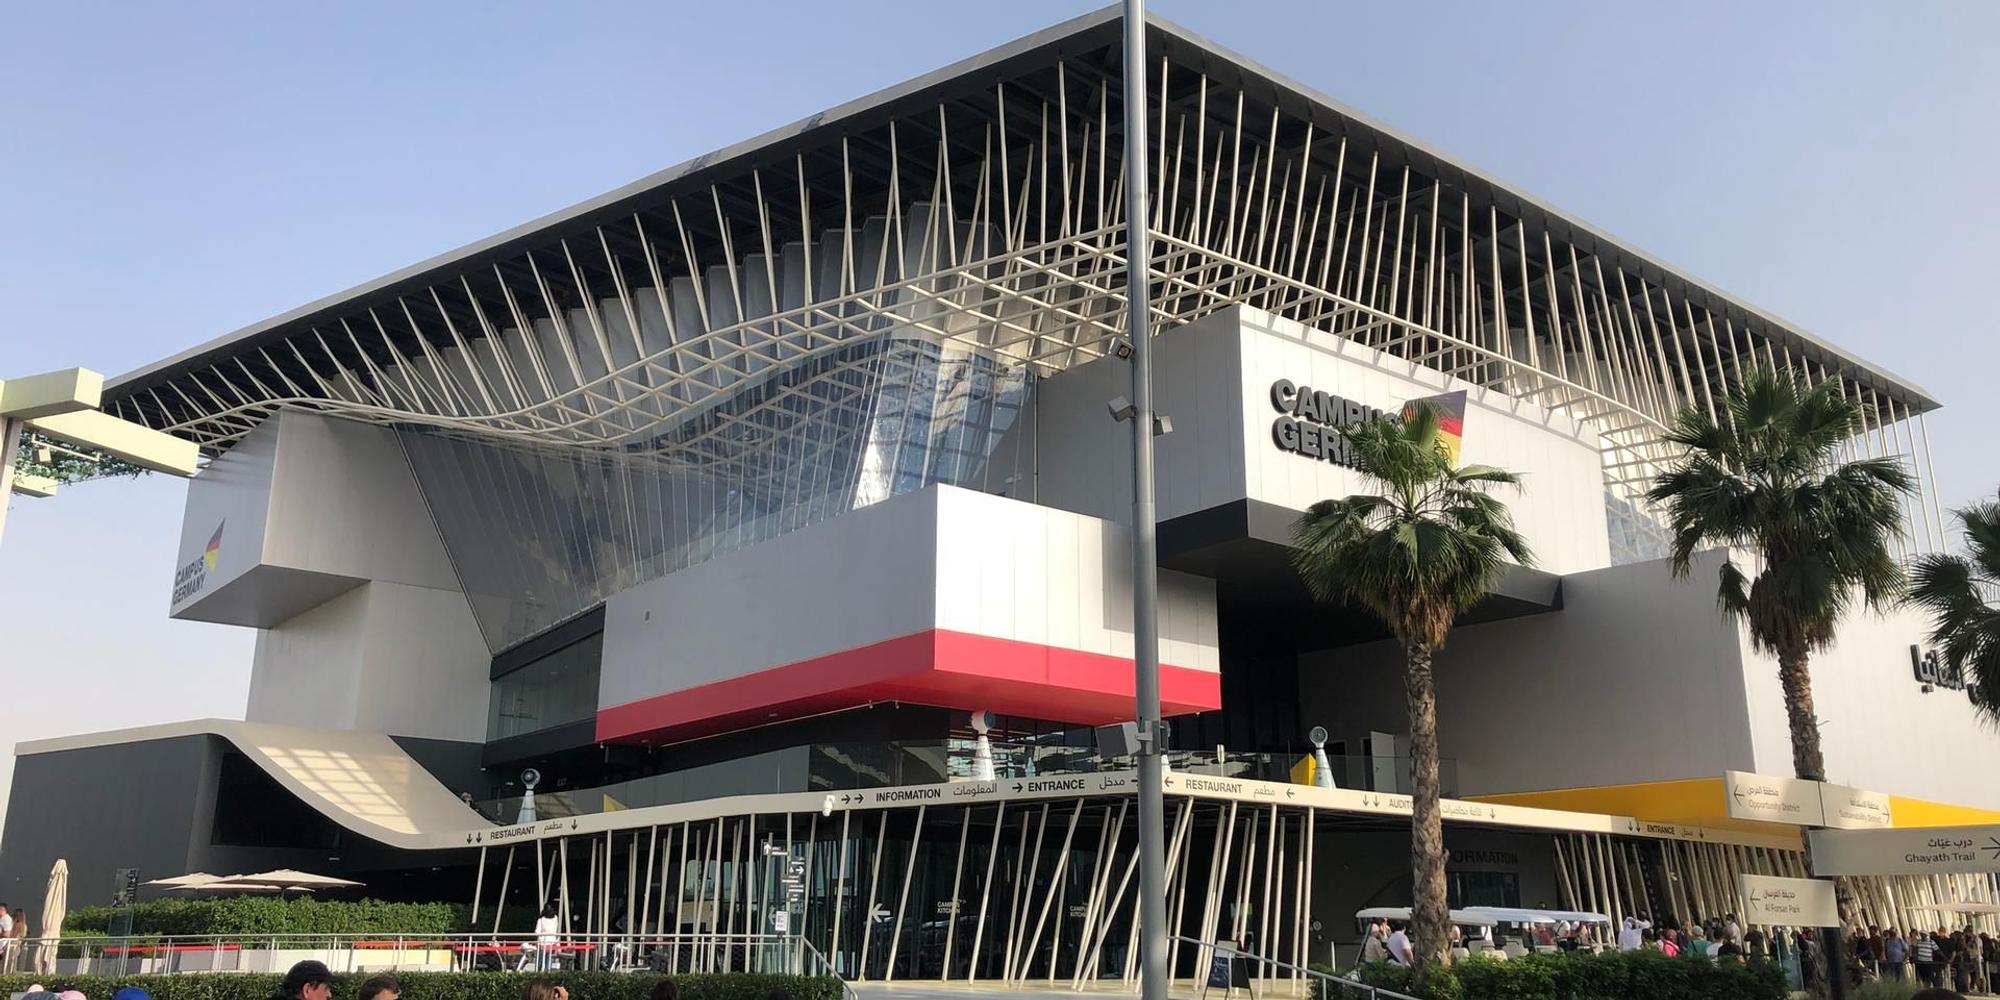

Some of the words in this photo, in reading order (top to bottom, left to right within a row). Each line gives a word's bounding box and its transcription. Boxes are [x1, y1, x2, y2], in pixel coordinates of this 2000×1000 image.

[175, 555, 205, 587] CAMPUS
[172, 571, 207, 606] GERMANY
[1028, 779, 1085, 792] ENTRANCE
[1099, 776, 1126, 790] مدخل
[1185, 779, 1243, 794] RESTAURANT
[876, 788, 941, 802] INFORMATION
[953, 783, 998, 798] المعلومات
[1253, 784, 1276, 798] مطعم
[1389, 799, 1414, 809] AUDIT
[490, 826, 536, 840] RESTAURANT
[544, 821, 563, 834] مطعم
[1646, 824, 1675, 835] ENTRANCE
[1953, 838, 1973, 848] درب
[1453, 849, 1518, 864] ORMATION
[1905, 852, 1950, 865] Ghayath
[1952, 852, 1975, 861] Trail
